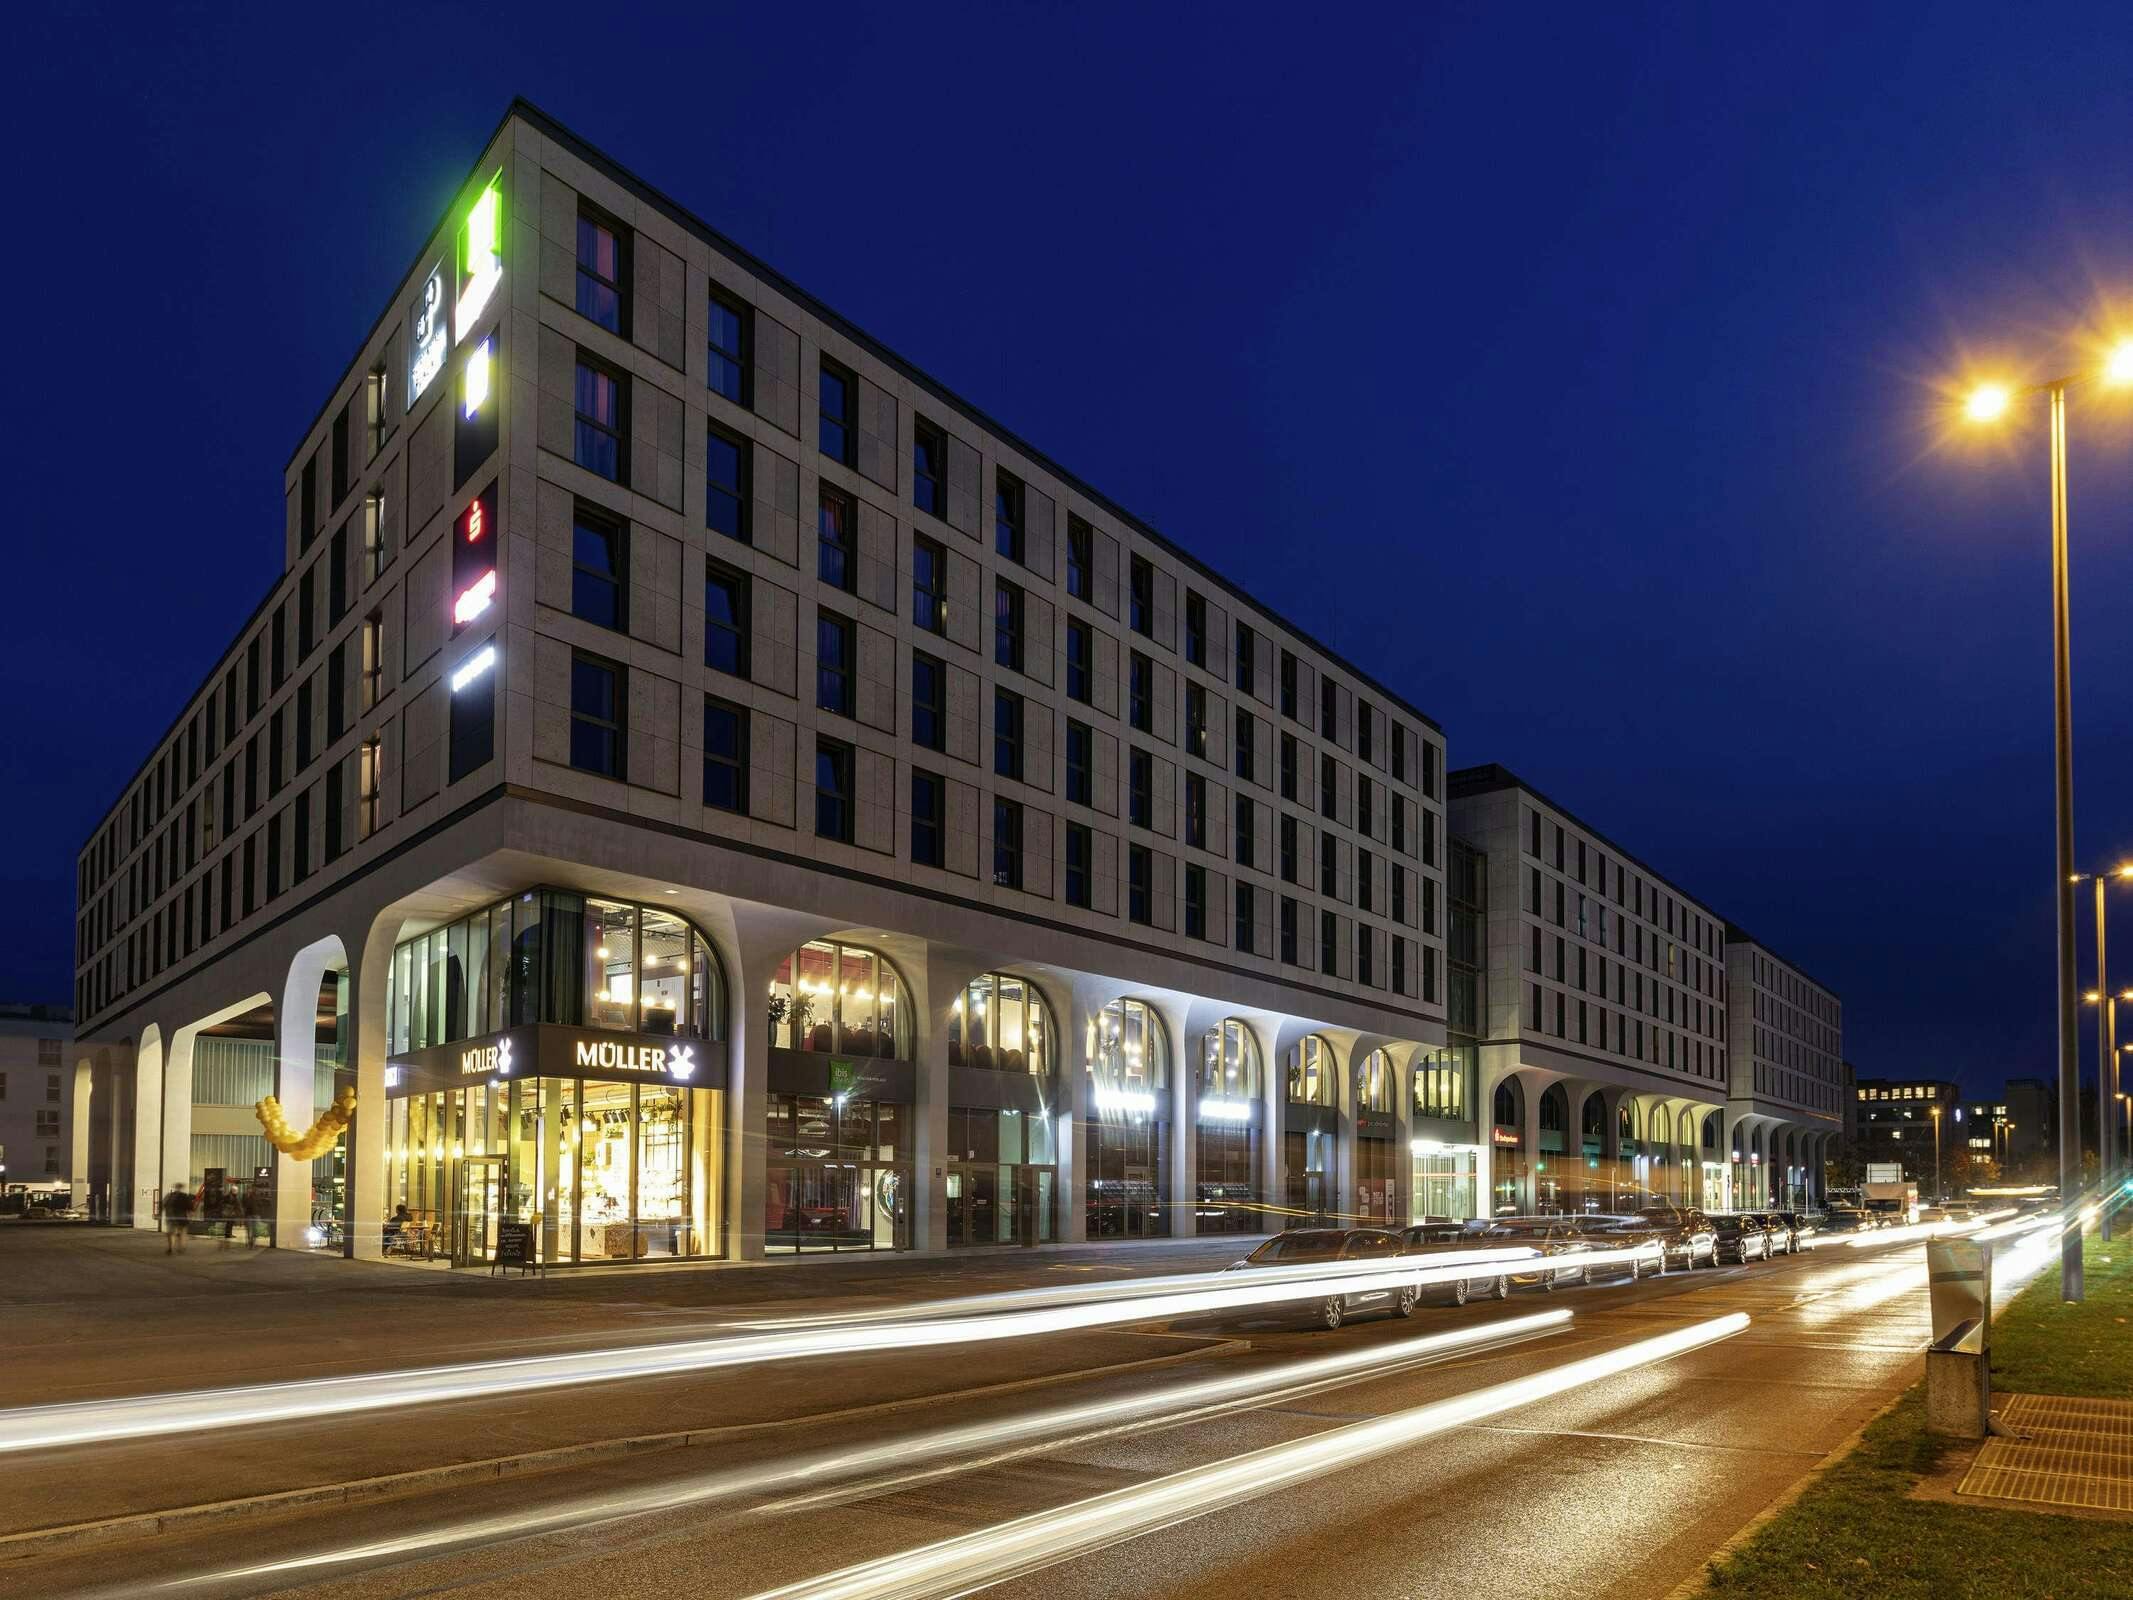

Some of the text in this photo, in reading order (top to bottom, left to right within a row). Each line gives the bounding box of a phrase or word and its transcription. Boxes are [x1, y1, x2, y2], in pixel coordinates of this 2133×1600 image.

[462, 1047, 499, 1075] MÜLLER
[577, 1041, 667, 1072] MÜLLER
[835, 1067, 848, 1077] ibis
